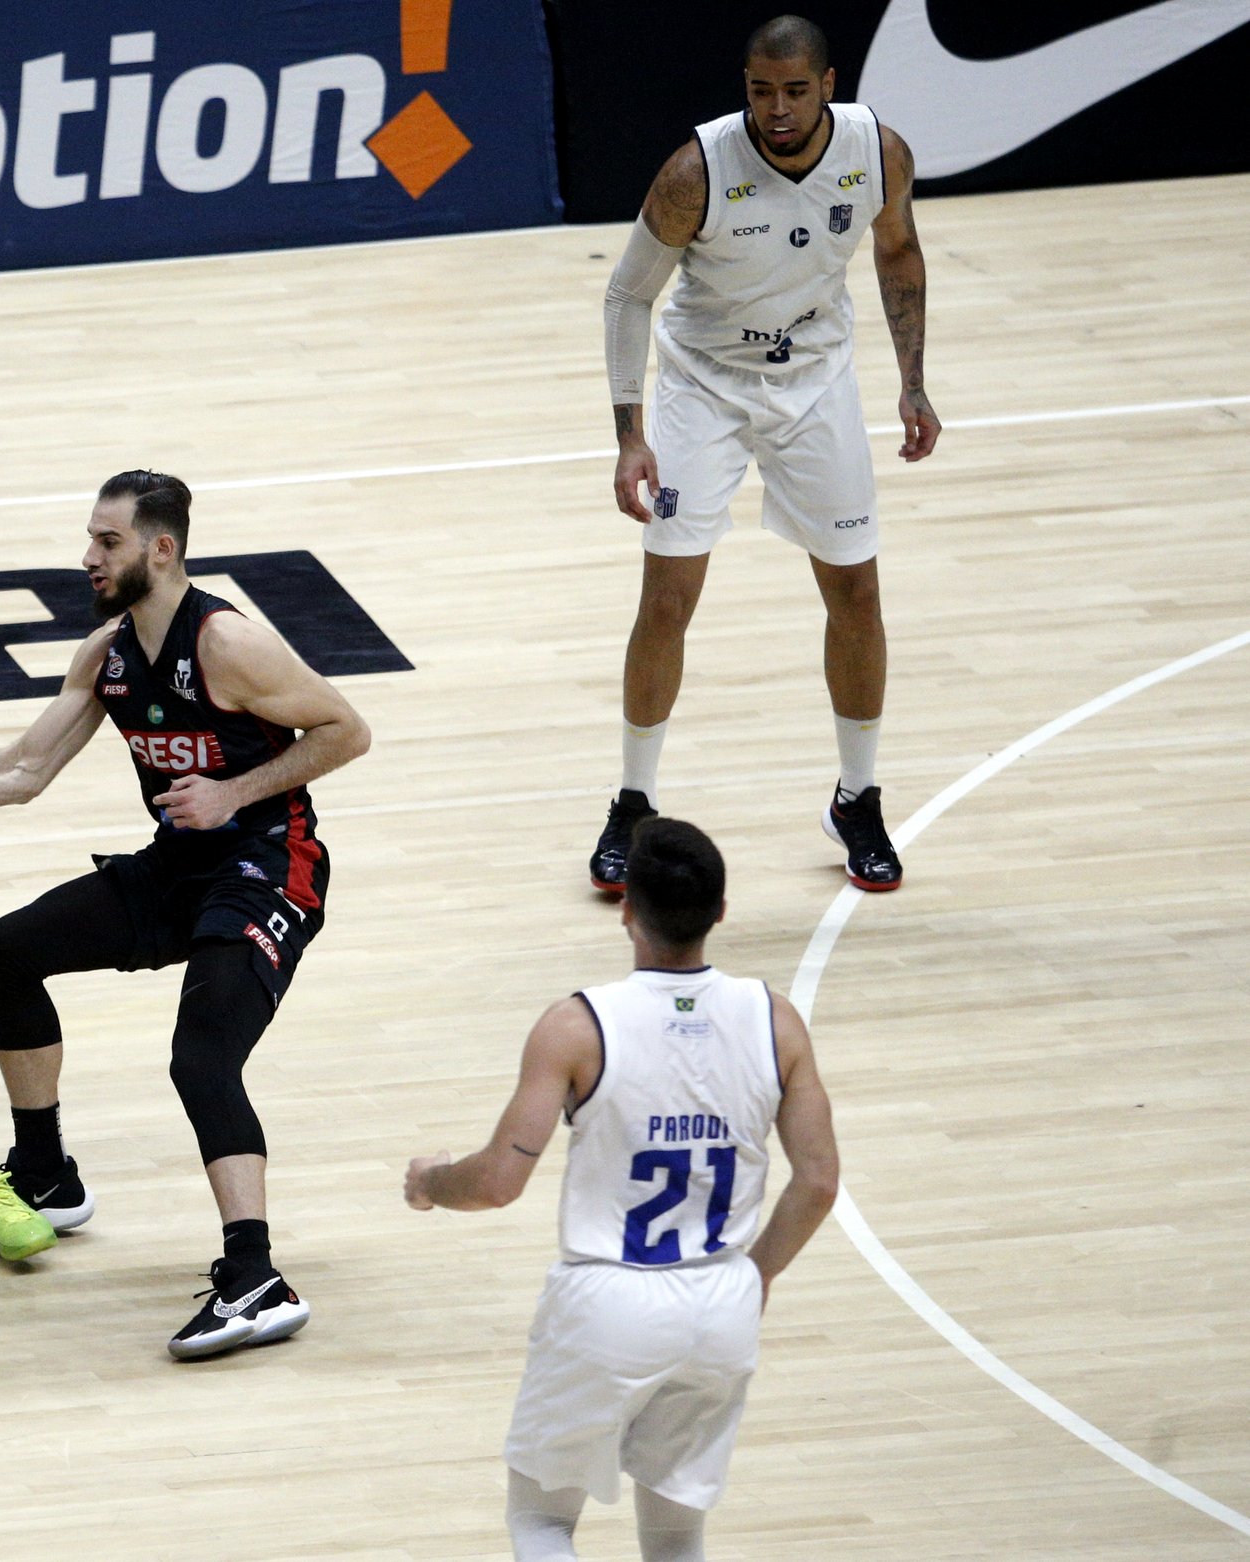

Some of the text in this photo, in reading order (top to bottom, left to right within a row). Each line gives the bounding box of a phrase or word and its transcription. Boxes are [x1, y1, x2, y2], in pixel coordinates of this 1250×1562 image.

[838, 172, 866, 188] CVC
[726, 184, 757, 200] CVC
[104, 685, 127, 695] FIESP
[129, 735, 209, 771] SESI
[622, 1146, 737, 1266] 21
